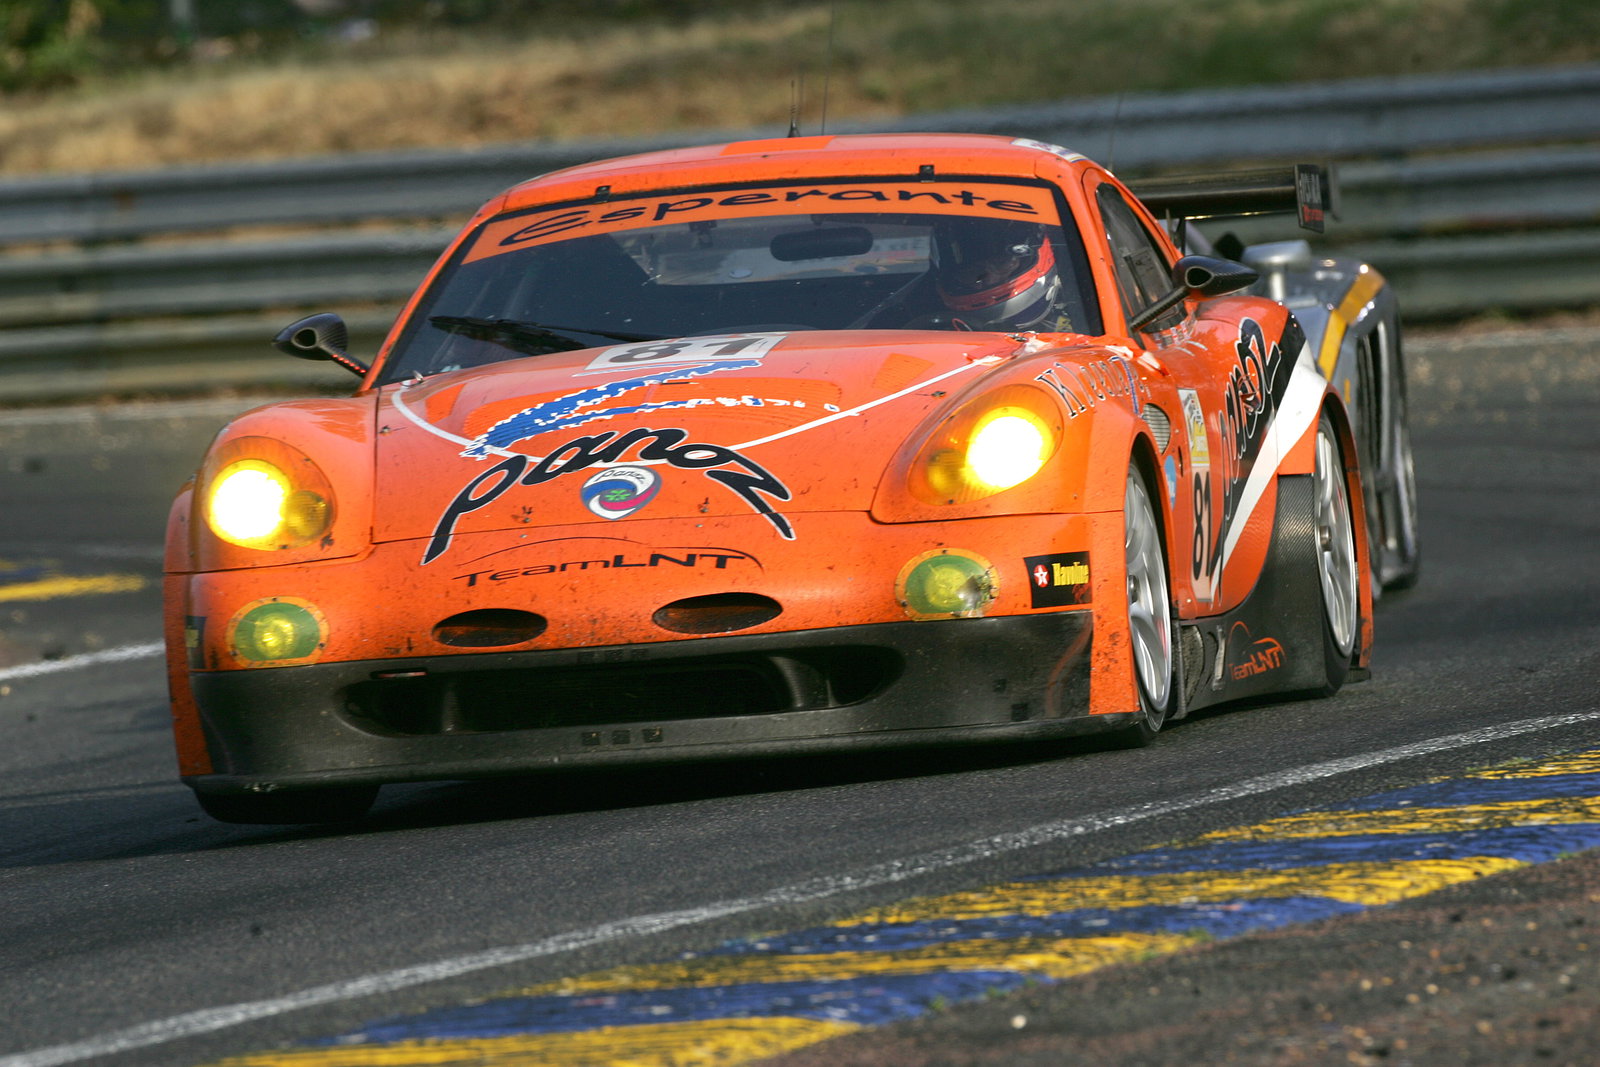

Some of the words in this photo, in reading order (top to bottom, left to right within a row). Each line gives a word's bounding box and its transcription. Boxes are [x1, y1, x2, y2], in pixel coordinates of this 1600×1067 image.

[497, 188, 1040, 247] Esperante
[608, 337, 765, 364] 81
[1192, 471, 1213, 583] 81
